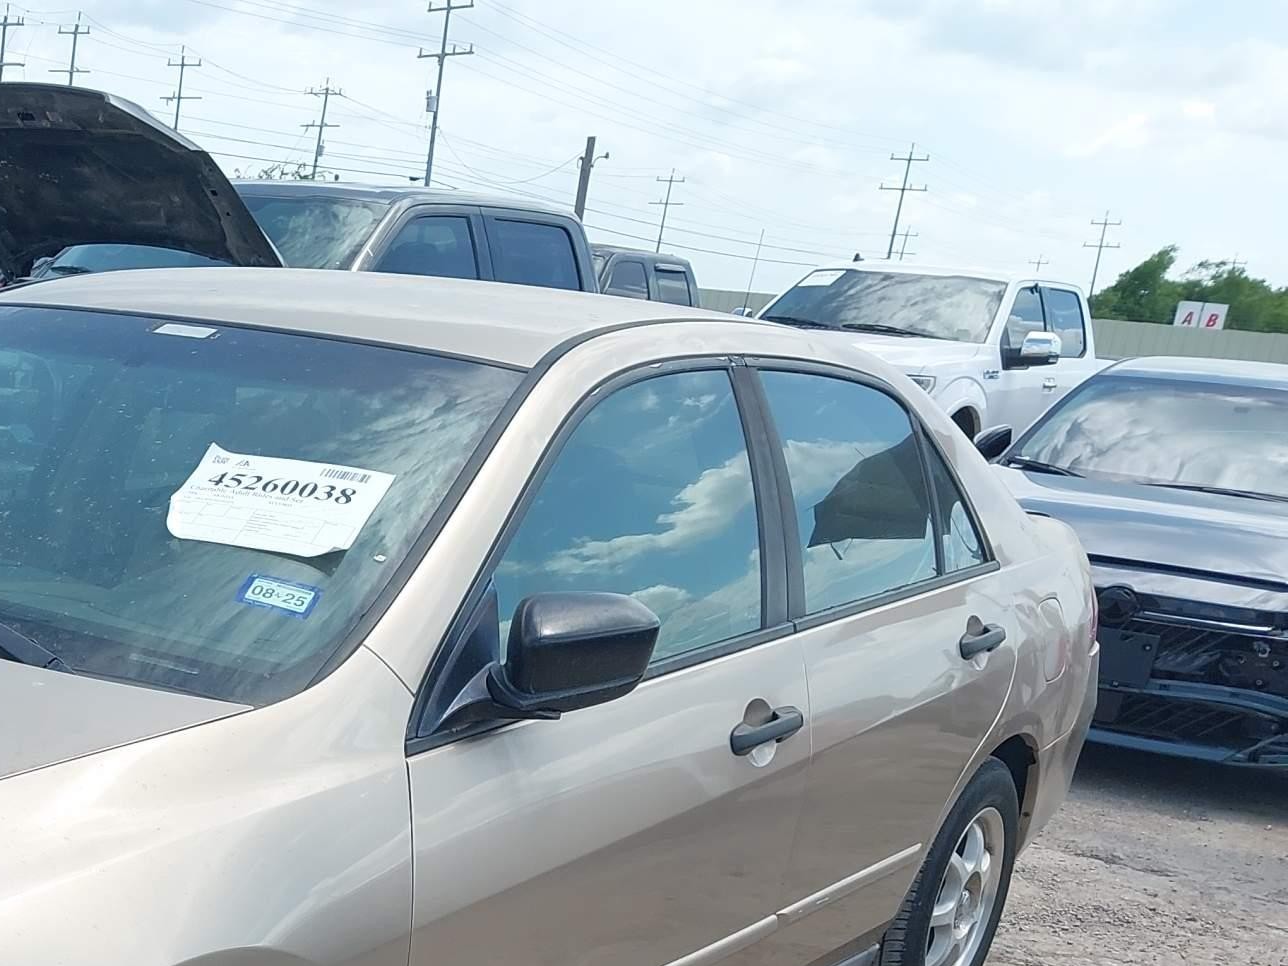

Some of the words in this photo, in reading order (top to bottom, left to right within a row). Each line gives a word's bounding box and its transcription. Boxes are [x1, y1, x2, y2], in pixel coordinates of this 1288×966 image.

[1182, 311, 1194, 325] A
[1206, 313, 1219, 327] B
[207, 471, 357, 505] 45260038
